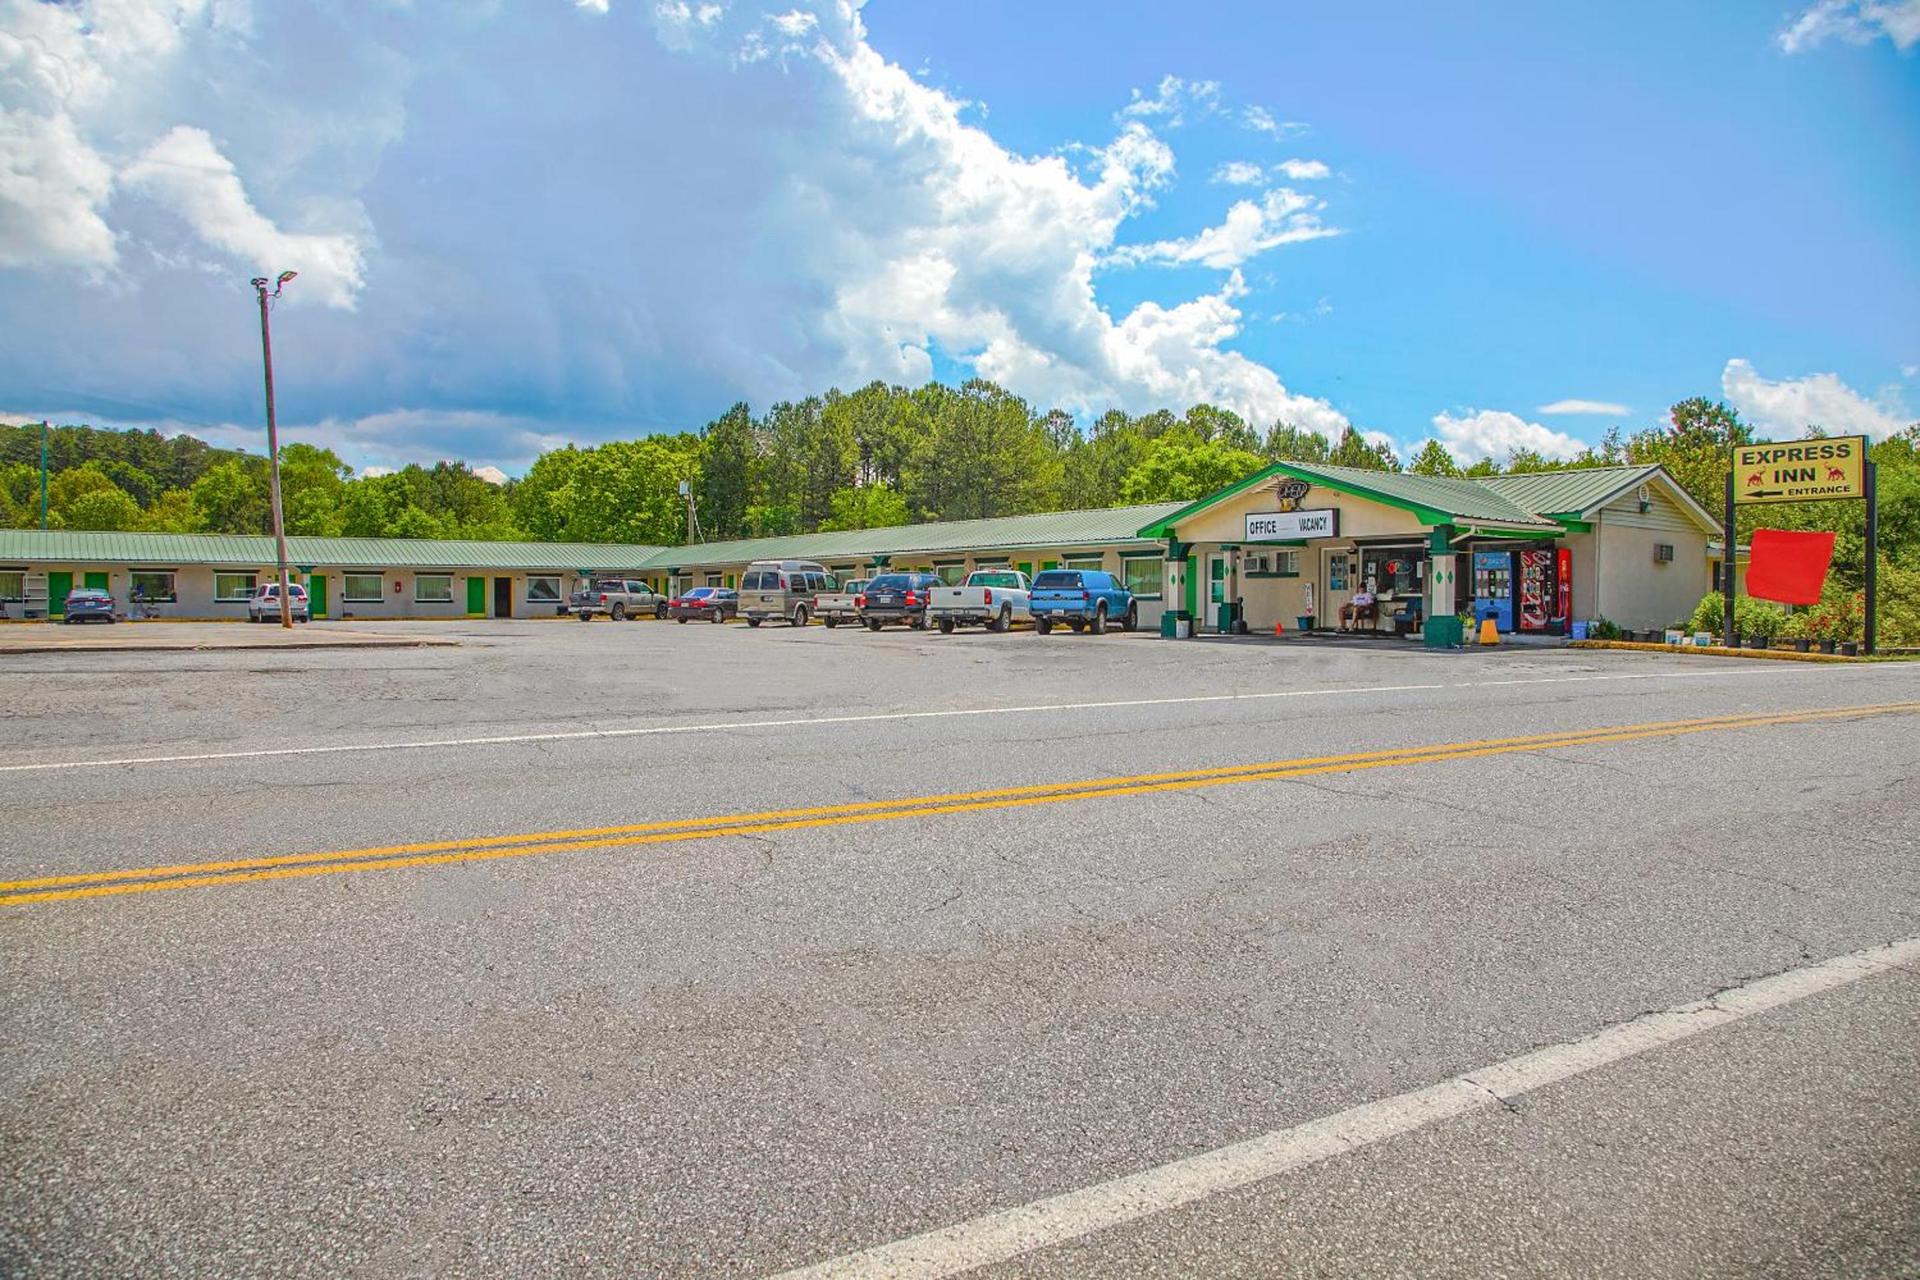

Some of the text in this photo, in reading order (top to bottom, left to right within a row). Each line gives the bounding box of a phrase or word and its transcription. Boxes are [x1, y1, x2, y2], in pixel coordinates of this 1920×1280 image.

[1742, 444, 1850, 465] EXPRESS
[1774, 468, 1816, 483] INN
[1788, 485, 1850, 496] ENTRANCE
[1249, 516, 1327, 535] OFFICE VACANCY
